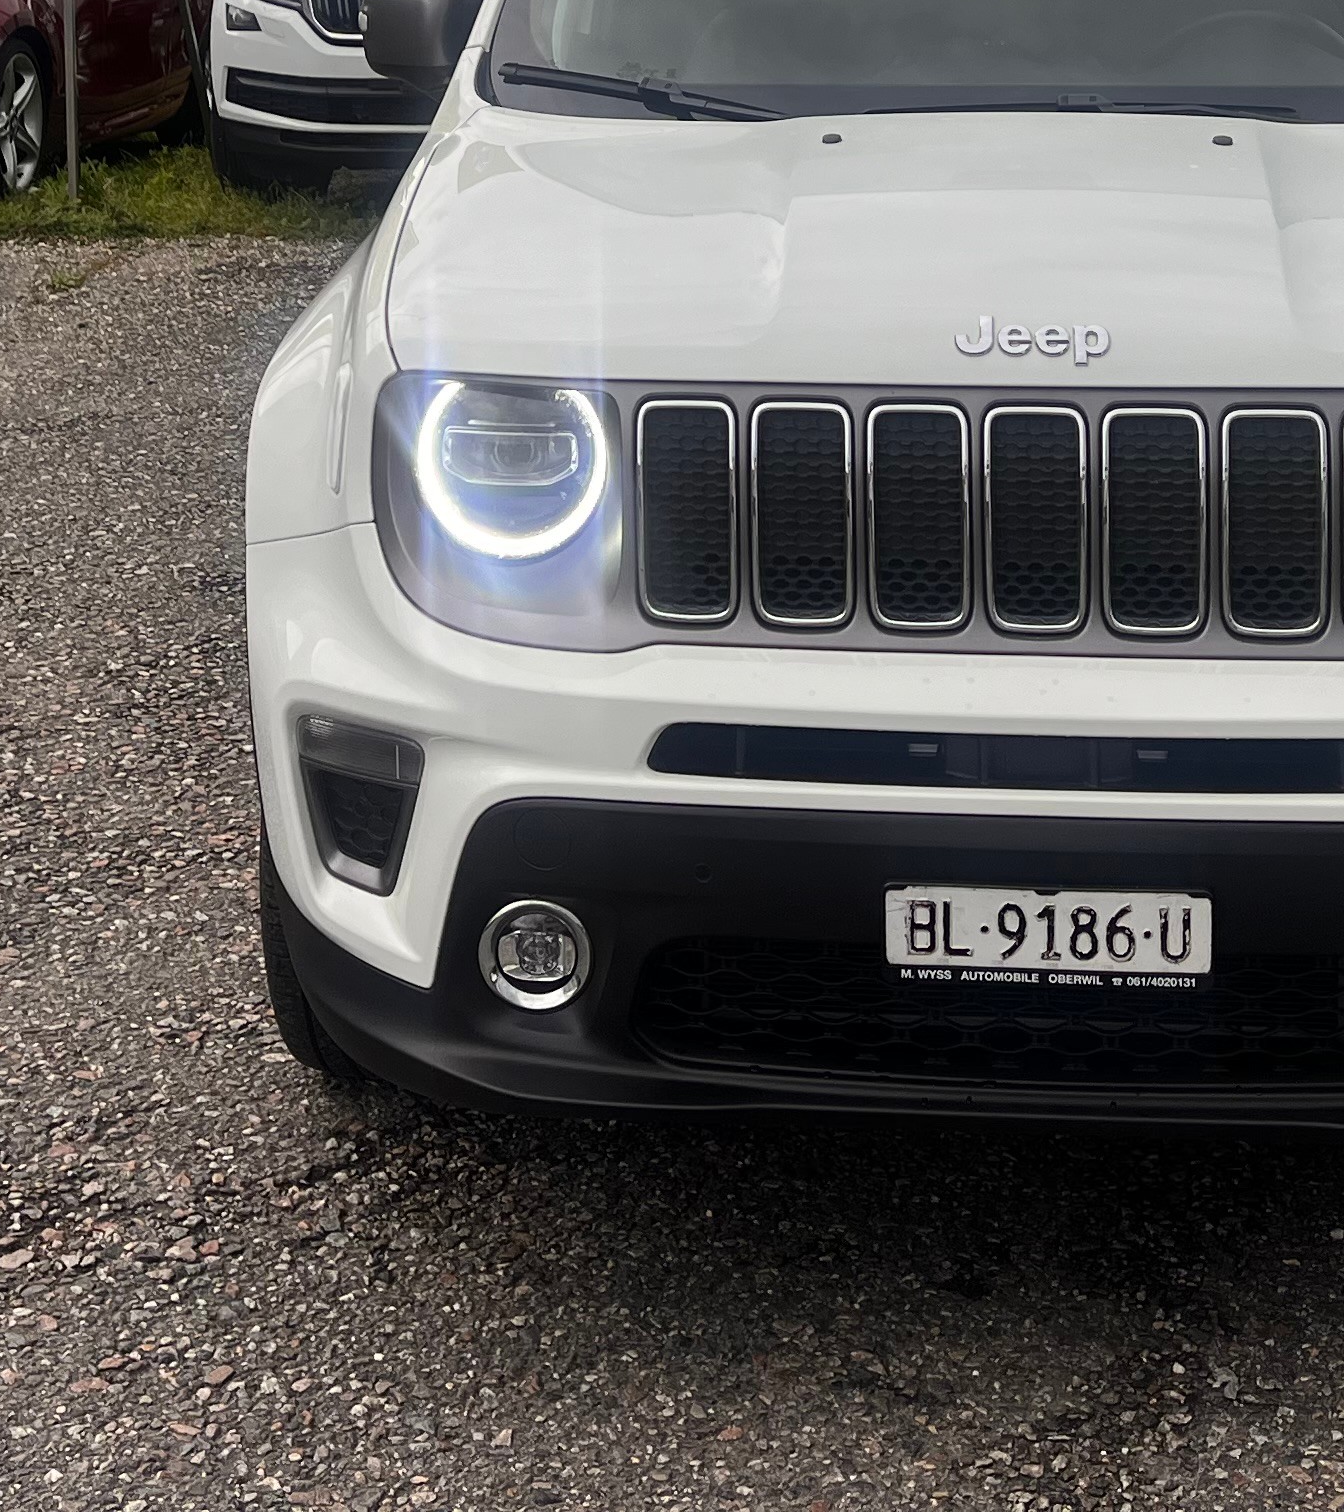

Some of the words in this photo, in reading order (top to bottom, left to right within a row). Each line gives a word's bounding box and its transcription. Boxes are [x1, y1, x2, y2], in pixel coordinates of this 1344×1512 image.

[954, 314, 1111, 367] Jeep
[900, 968, 915, 980] M.
[917, 969, 952, 981] WYSS
[960, 971, 1040, 984] AUTOMOBILE
[1048, 974, 1104, 986] OBERWIL
[1126, 976, 1196, 988] 061/4020131
